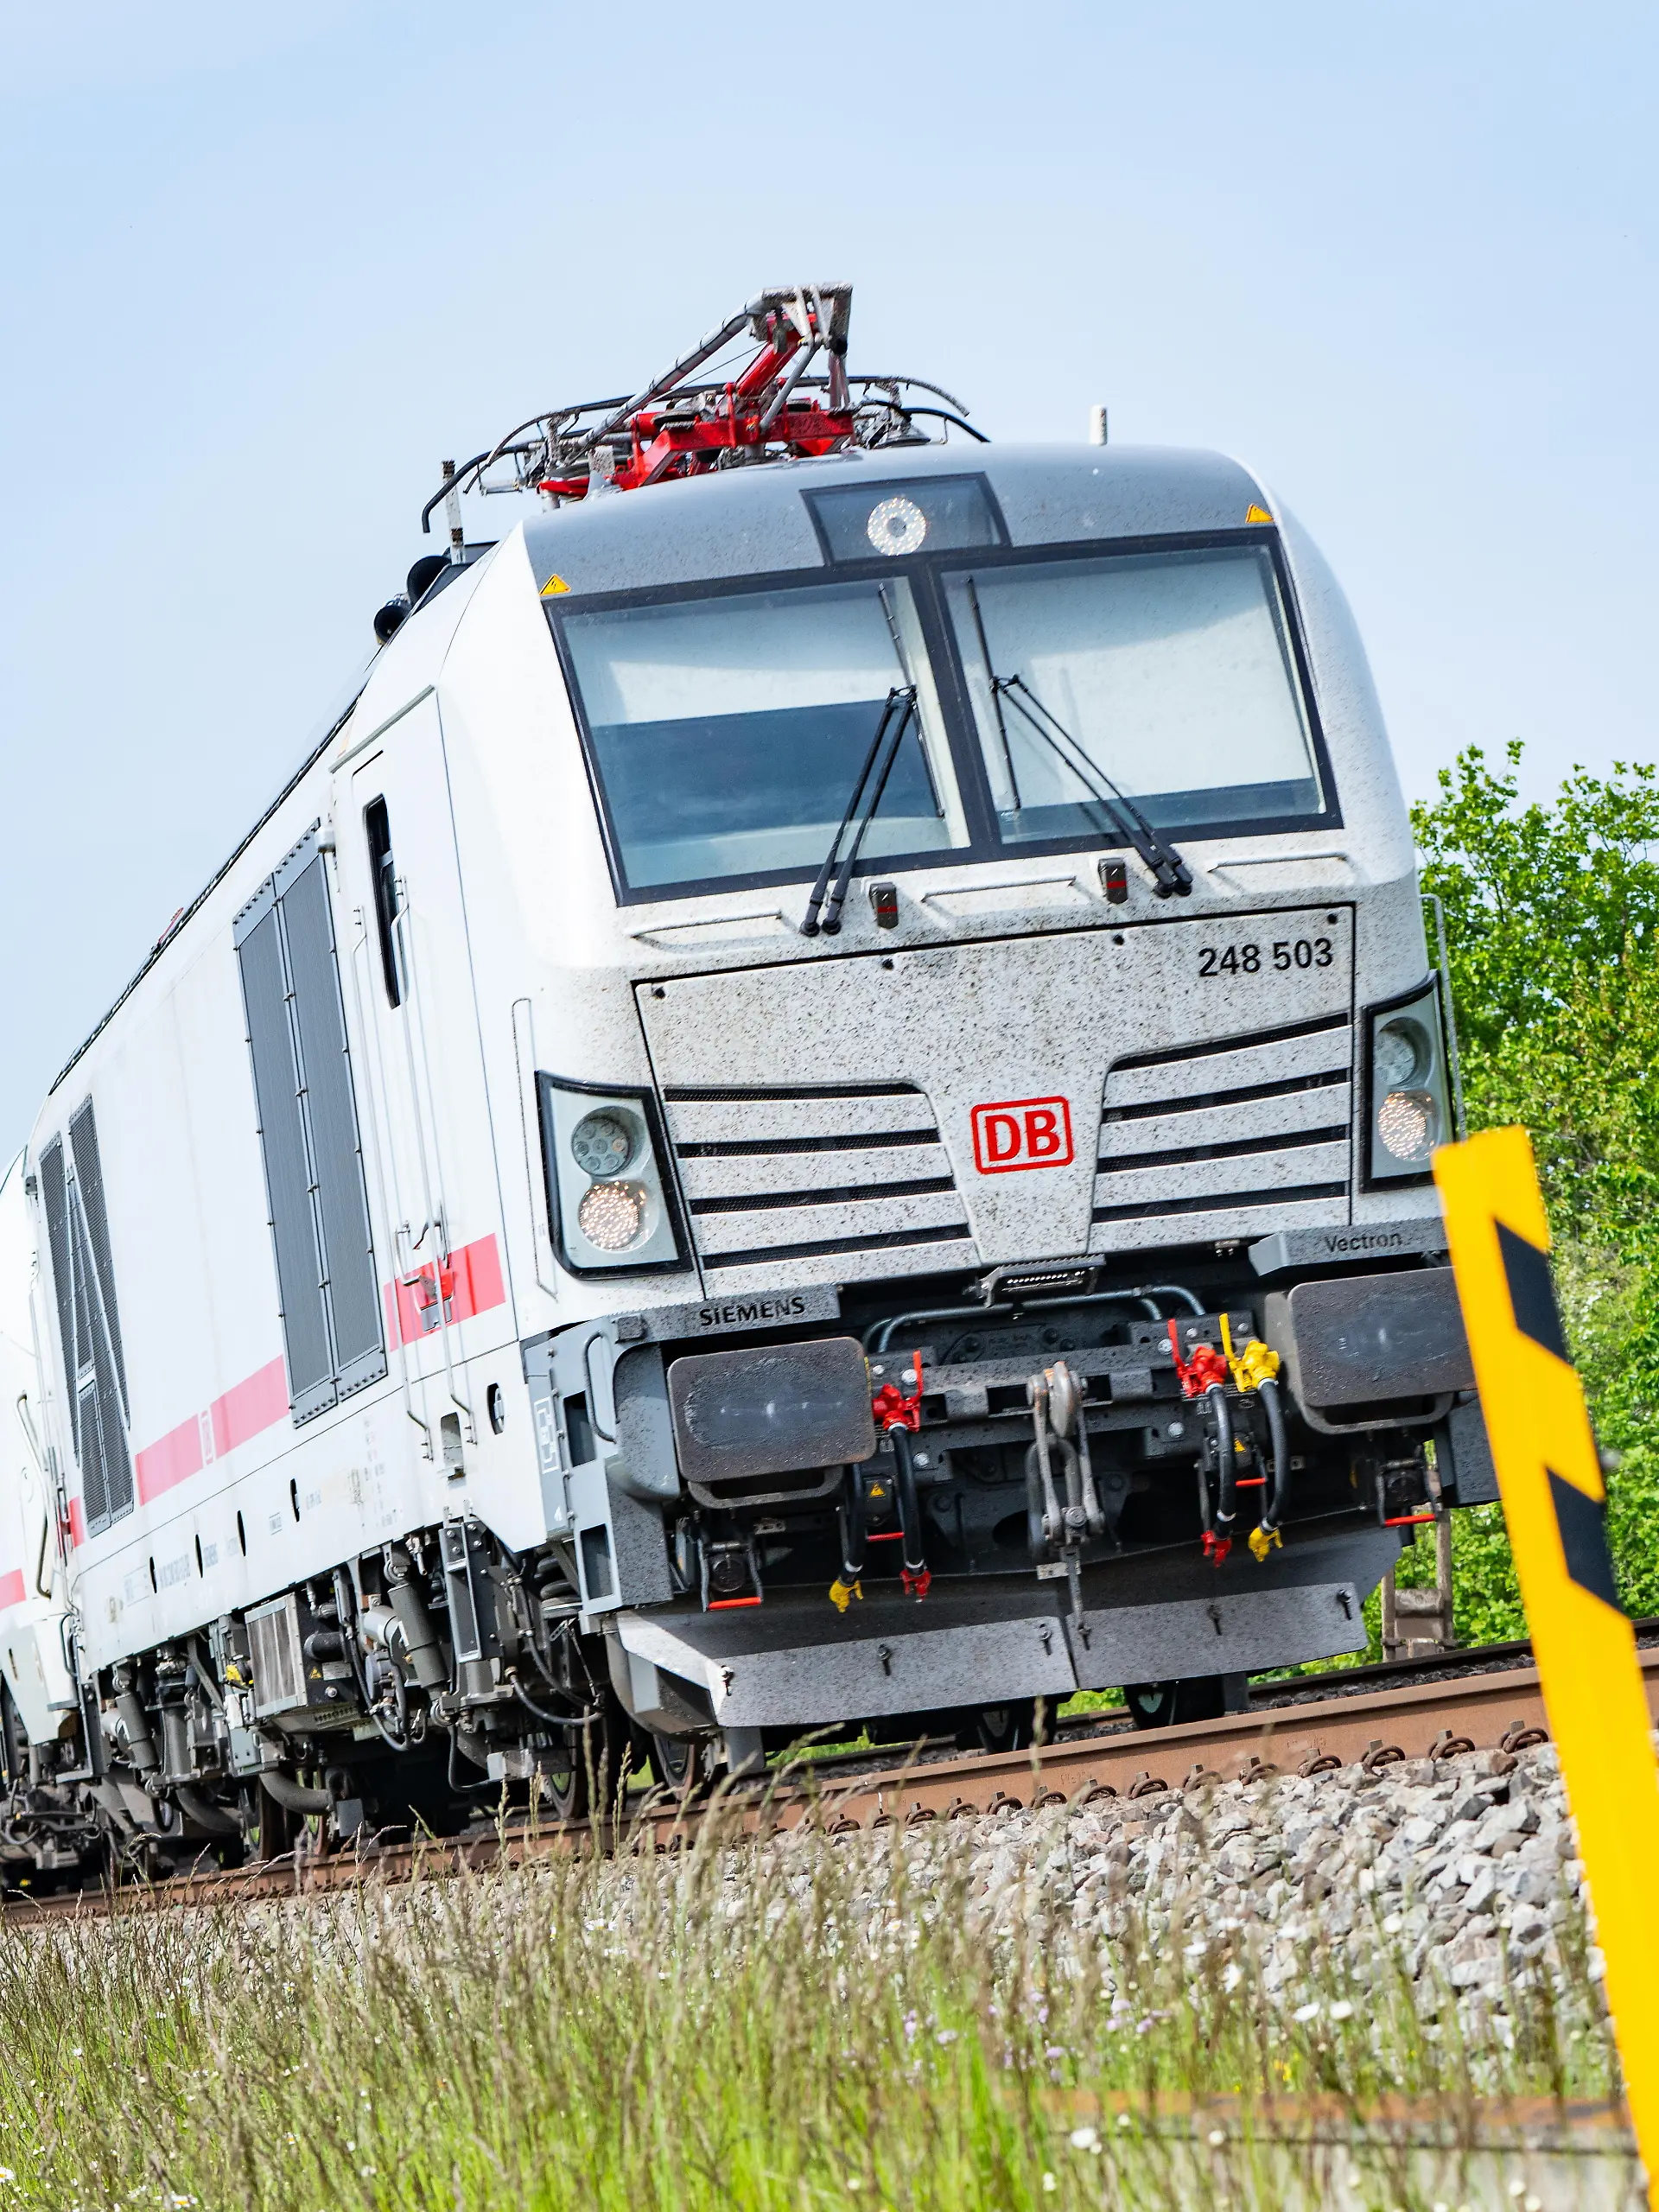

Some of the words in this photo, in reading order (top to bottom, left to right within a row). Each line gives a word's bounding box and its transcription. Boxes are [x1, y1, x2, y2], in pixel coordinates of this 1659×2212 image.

[1198, 943, 1262, 978] 248
[1272, 937, 1334, 971] 503
[983, 1108, 1062, 1163] DB
[1324, 1232, 1403, 1254] Vectron
[699, 1295, 806, 1326] SIEMENS
